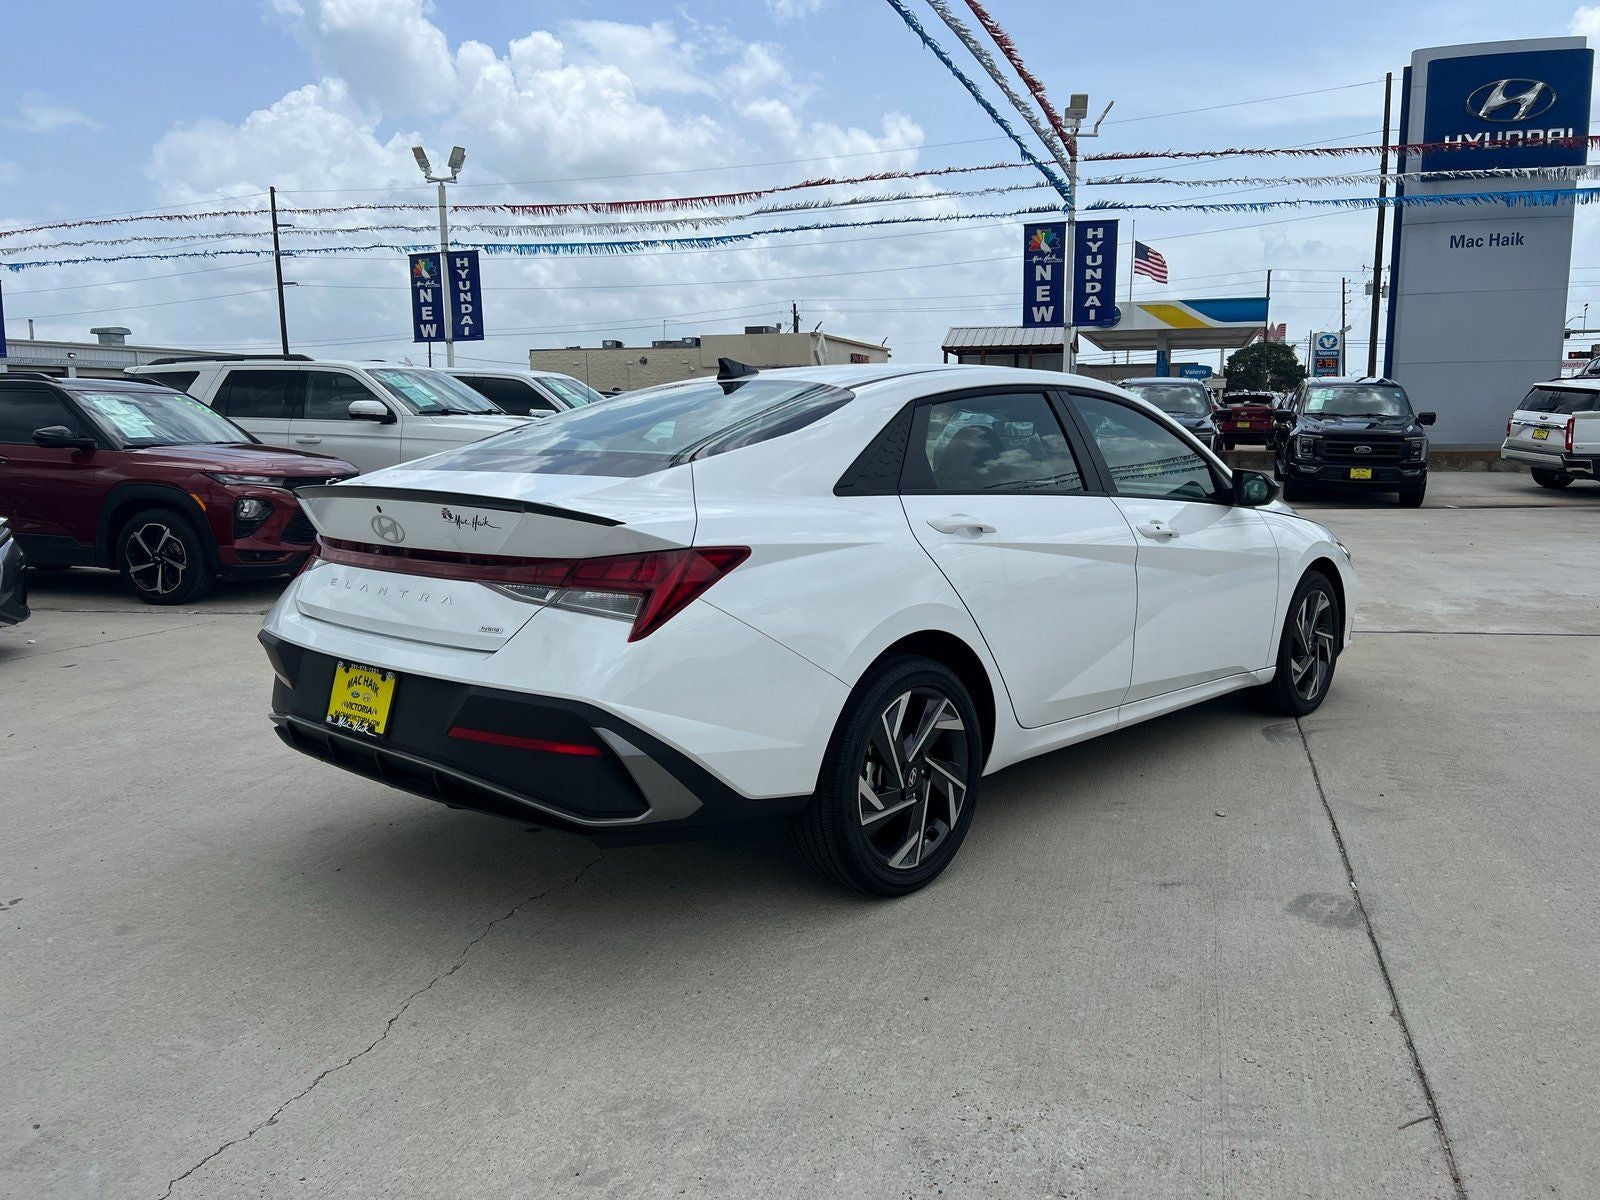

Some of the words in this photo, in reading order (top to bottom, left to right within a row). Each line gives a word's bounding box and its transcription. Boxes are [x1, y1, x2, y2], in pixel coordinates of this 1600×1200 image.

[1444, 128, 1574, 151] HYUNDAI
[1450, 235, 1484, 249] Mac
[1489, 232, 1525, 248] Haik
[1084, 227, 1104, 320] HYUNDAI
[455, 257, 474, 336] HYUNDAI
[1031, 264, 1054, 323] NEW
[419, 288, 437, 338] NEW
[453, 514, 471, 529] Mac
[471, 514, 502, 531] Haik
[329, 577, 454, 606] ELANTRA
[480, 625, 500, 633] hybrid
[347, 675, 363, 690] MAC
[363, 676, 380, 698] HAIK
[346, 701, 373, 715] VICTORIA
